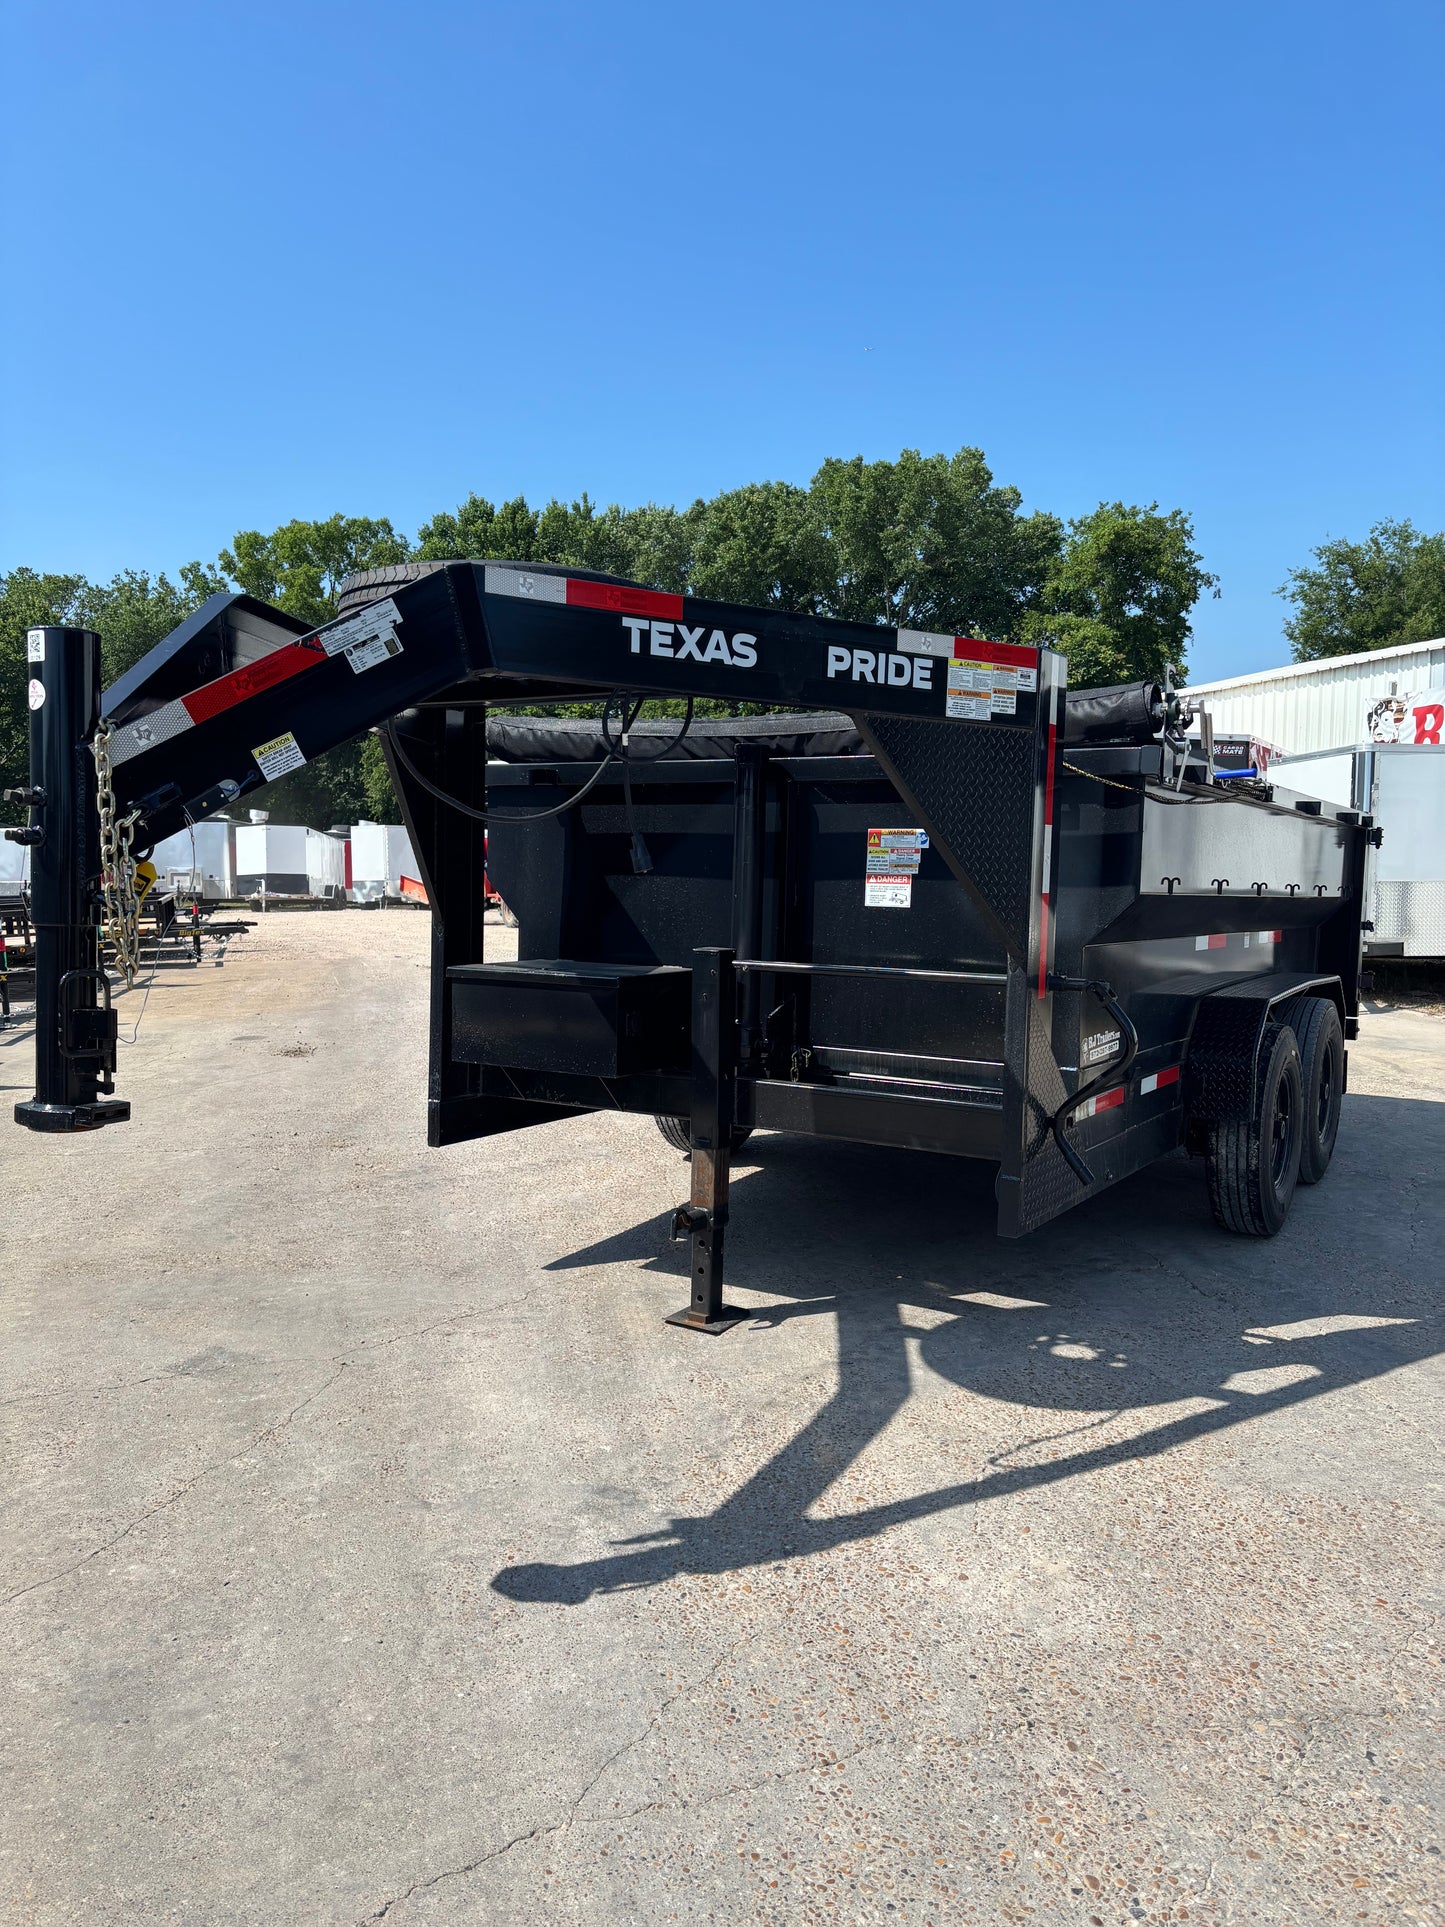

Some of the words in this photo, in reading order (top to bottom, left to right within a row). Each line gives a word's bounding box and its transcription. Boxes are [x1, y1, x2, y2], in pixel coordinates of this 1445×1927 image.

[622, 616, 757, 668] TEXAS
[827, 645, 933, 690] PRIDE
[263, 736, 290, 753] CAUTION
[877, 875, 908, 883] DANGER
